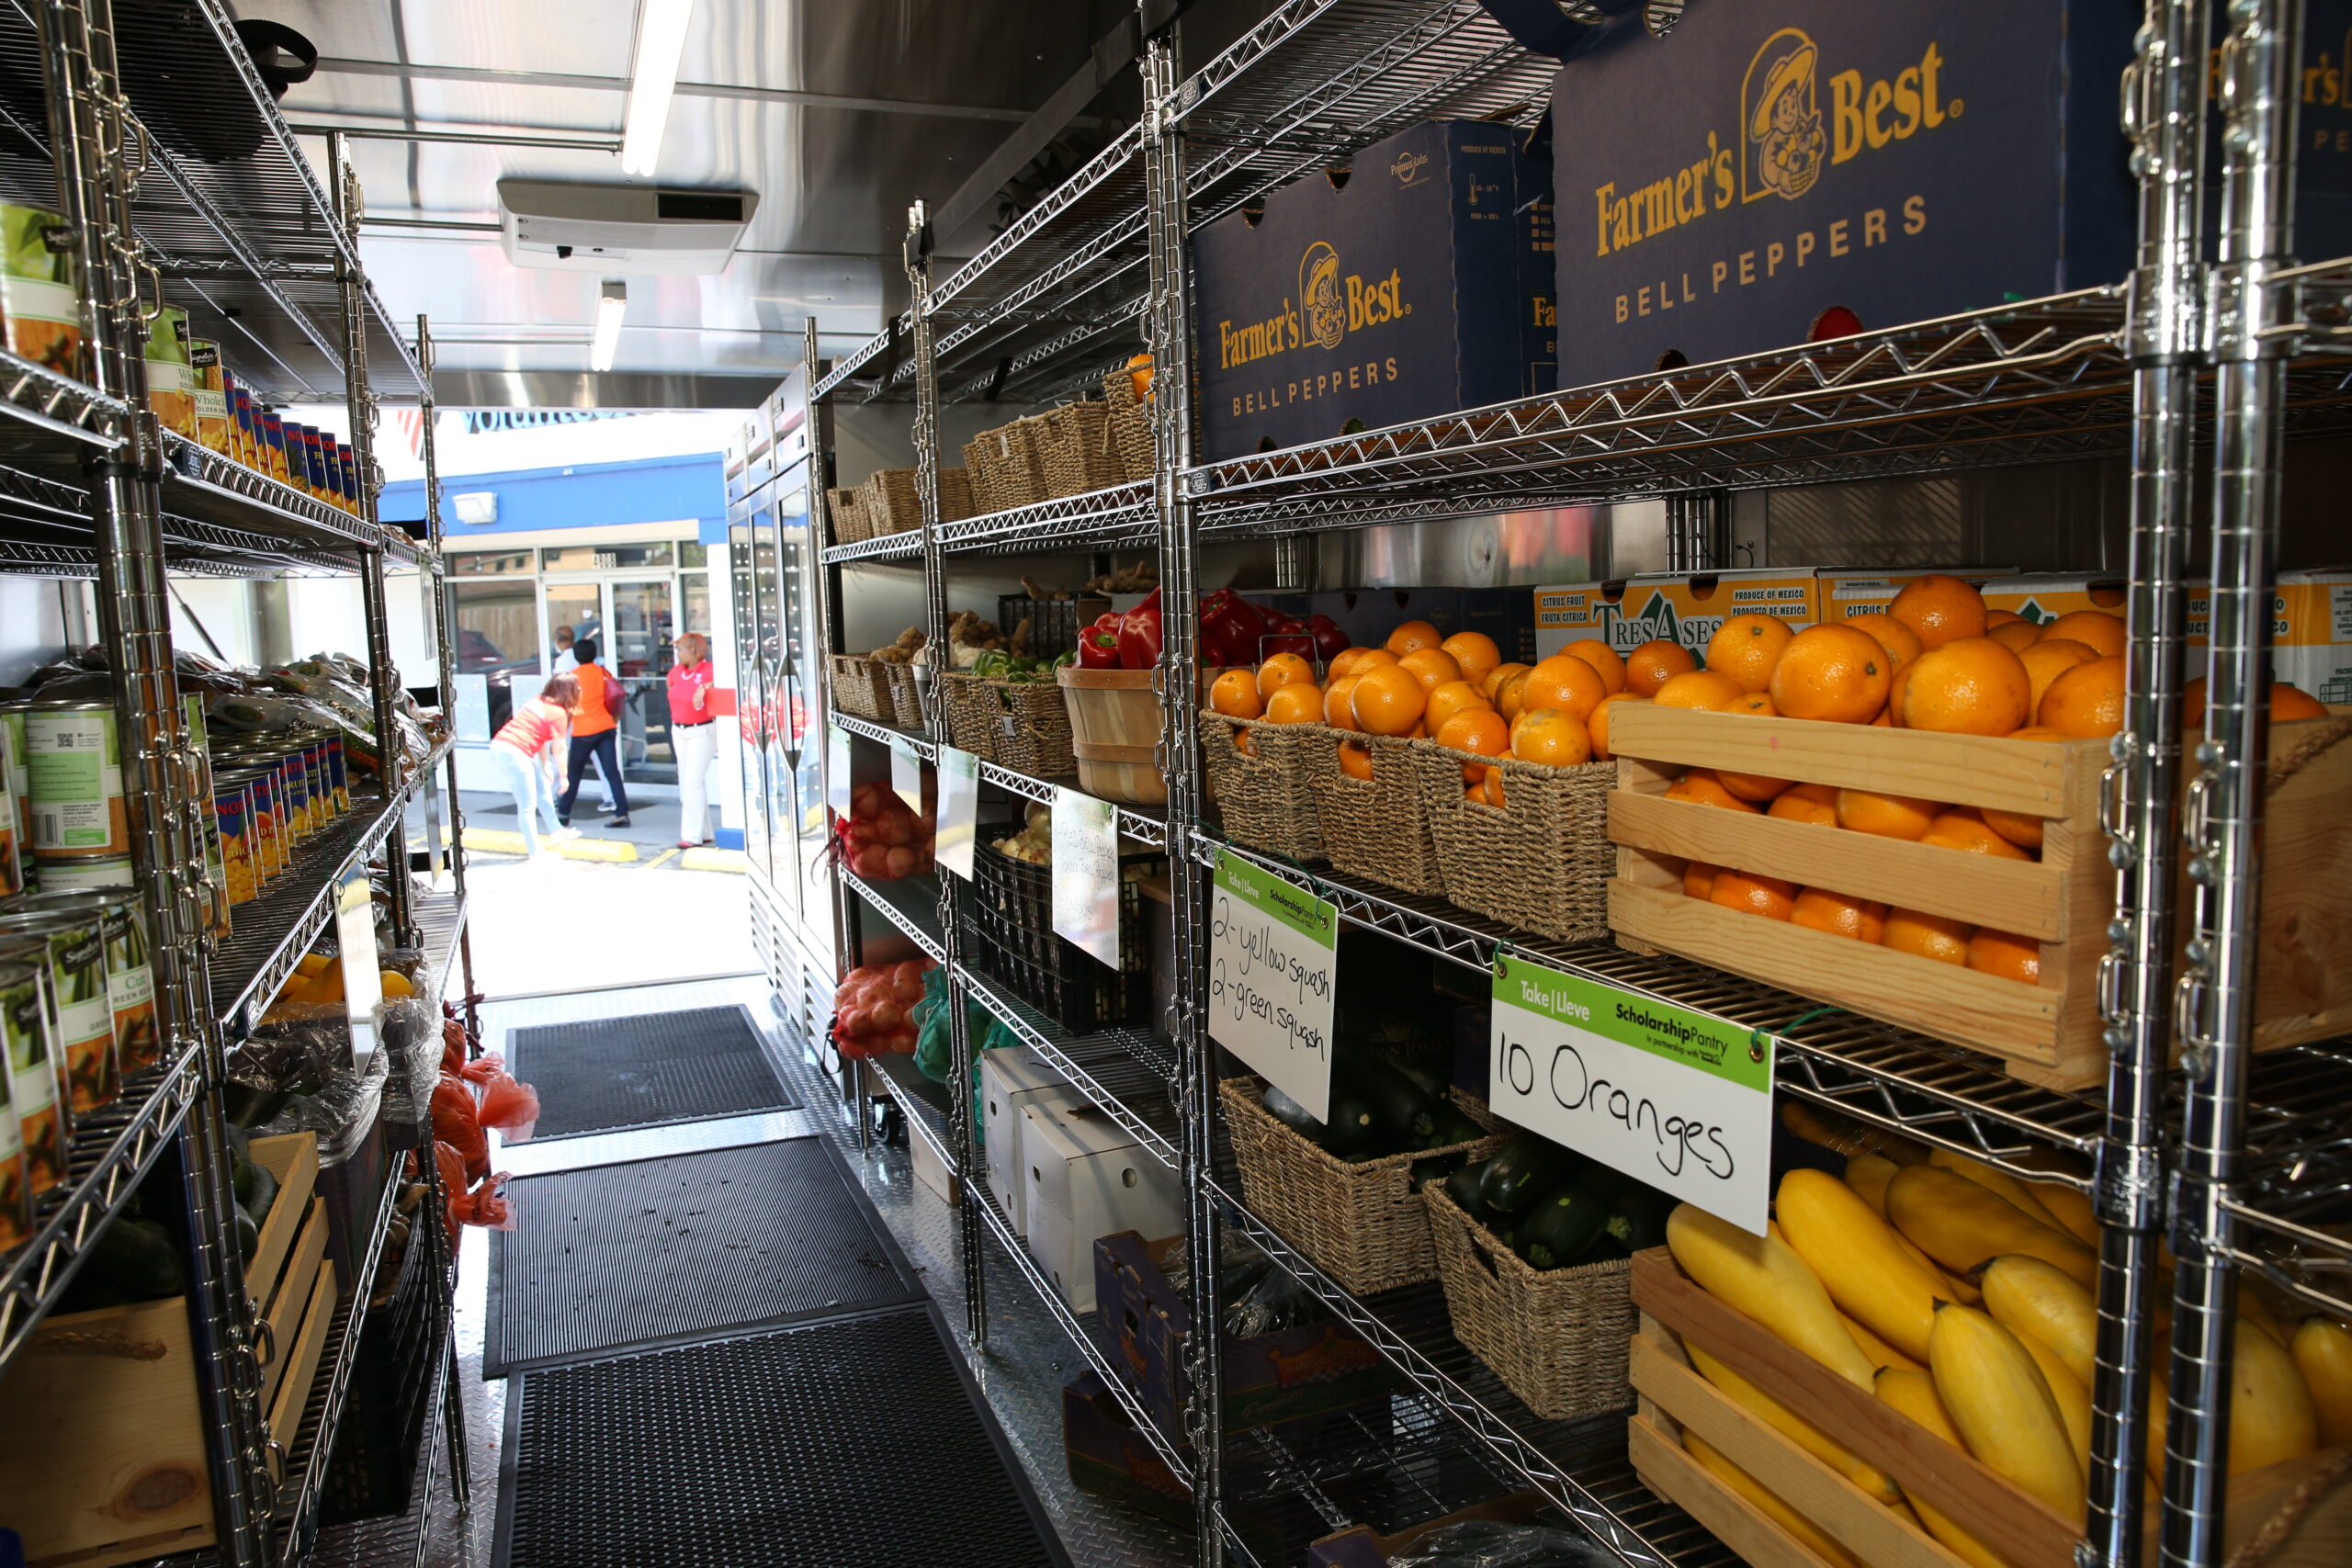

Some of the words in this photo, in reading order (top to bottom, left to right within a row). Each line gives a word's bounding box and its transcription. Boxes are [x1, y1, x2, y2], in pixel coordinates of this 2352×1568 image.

[1595, 130, 1735, 257] Farmer's
[1615, 273, 1696, 324] BELL
[1712, 195, 1927, 294] PEPPERS
[1219, 297, 1299, 369] Farmer's
[1232, 388, 1280, 417] BELL
[1288, 356, 1397, 404] PEPPERS
[1541, 613, 1560, 623] FRUTA
[1562, 612, 1588, 623] CITRICA
[1542, 597, 1565, 607] CITRUS
[1566, 595, 1585, 606] FRUIT
[1733, 606, 1767, 616] PRODUCTO
[1769, 606, 1778, 615] DE
[1779, 605, 1806, 615] MEXICO
[1735, 590, 1765, 600] PRODUCE
[1767, 590, 1776, 599] OF
[1778, 589, 1804, 599] MEXICO
[1289, 957, 1329, 1005] squash
[1277, 1007, 1325, 1062] squash
[1653, 1038, 1685, 1055] partnership
[1499, 1032, 1533, 1096] 10
[1550, 1043, 1735, 1180] Oranges
